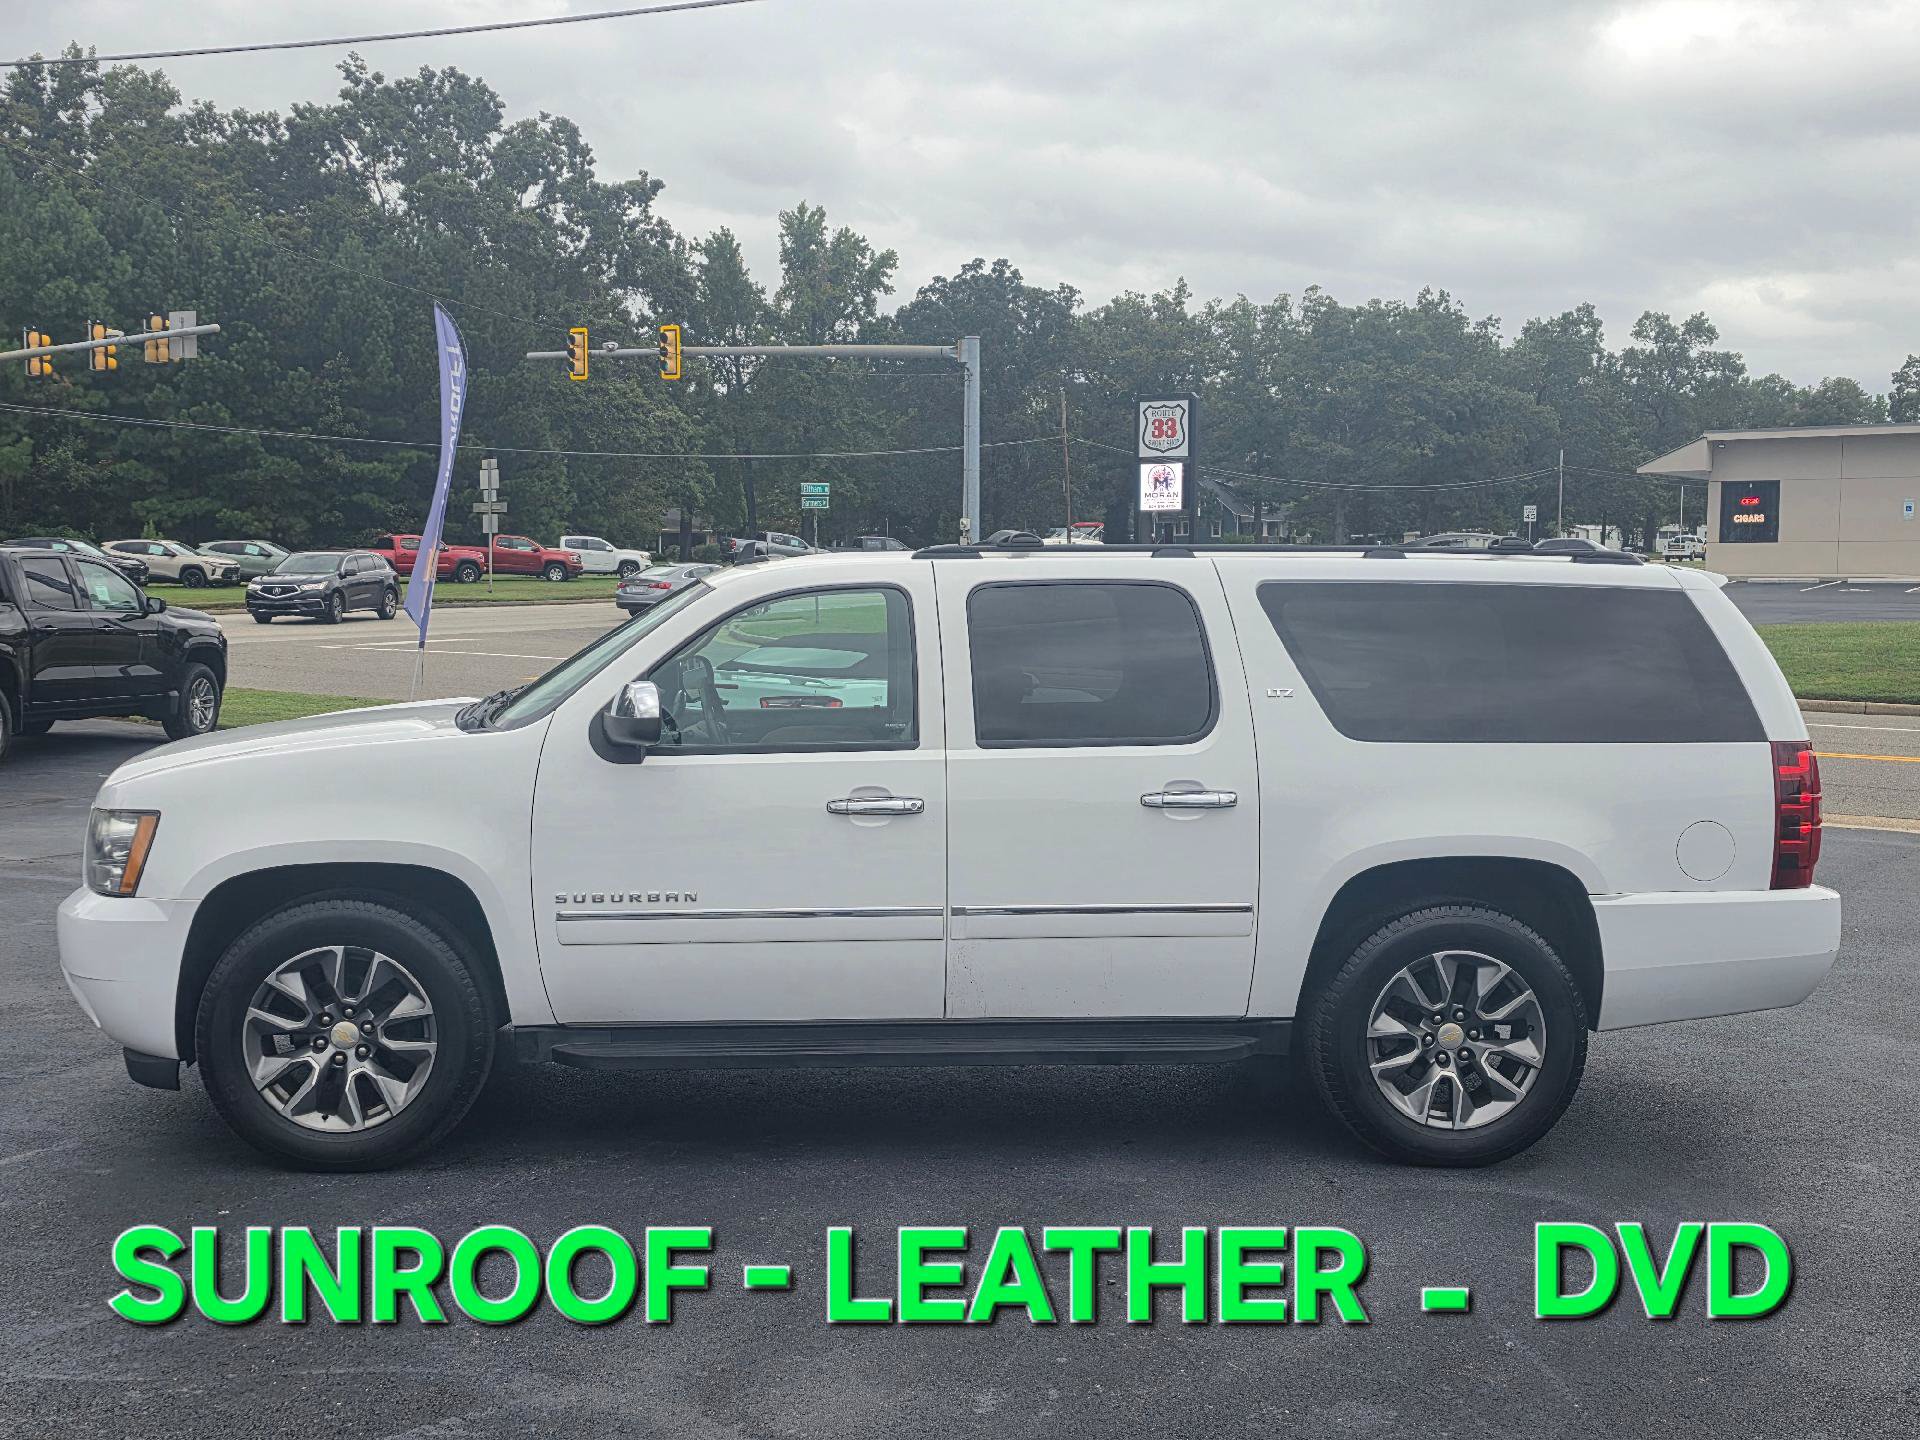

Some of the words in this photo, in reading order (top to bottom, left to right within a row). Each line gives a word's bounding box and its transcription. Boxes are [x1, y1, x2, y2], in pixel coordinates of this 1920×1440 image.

[1151, 409, 1177, 418] ROUTE
[1151, 418, 1178, 439] 33
[1733, 513, 1765, 523] CIGARS
[1267, 688, 1294, 698] LTZ
[555, 891, 698, 904] SUBURBAN
